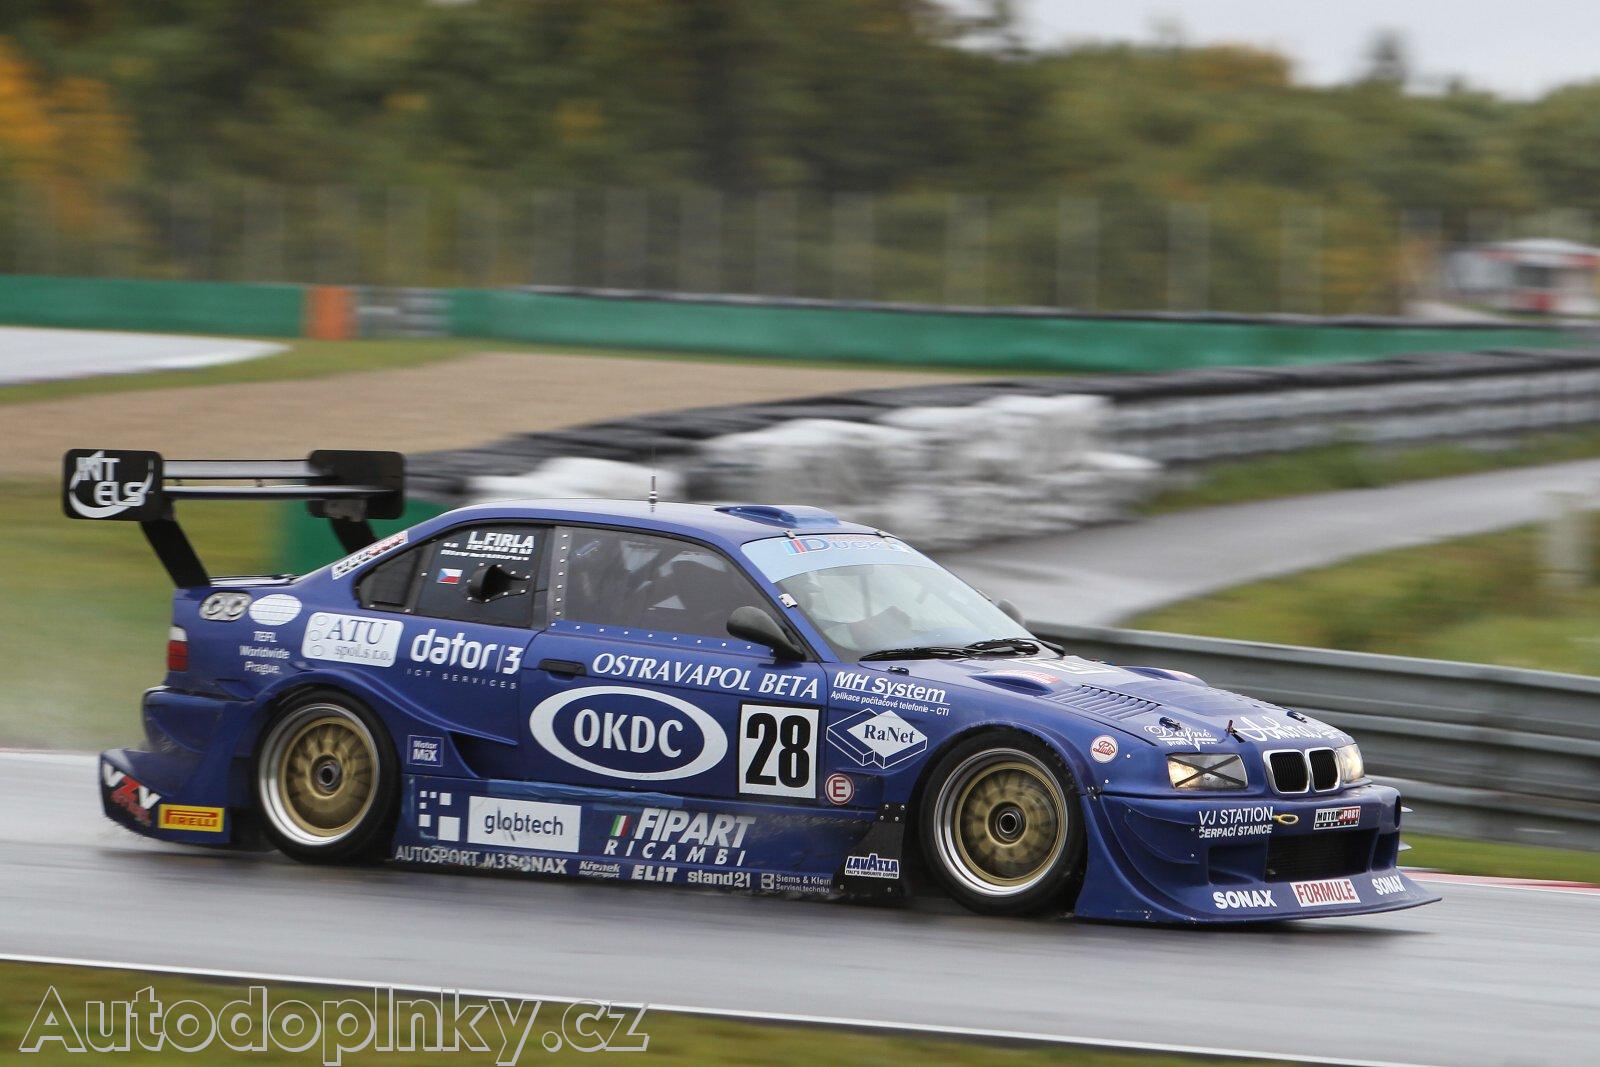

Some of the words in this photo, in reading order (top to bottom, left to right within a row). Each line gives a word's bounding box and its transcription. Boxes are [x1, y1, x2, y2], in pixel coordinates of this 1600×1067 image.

[325, 617, 387, 644] ATU
[239, 645, 290, 660] Worldwide
[244, 661, 281, 676] Prague
[592, 654, 751, 691] OSTRAVAPOL
[759, 673, 818, 699] BETA
[441, 673, 517, 690] SERVICES
[833, 671, 870, 690] MH
[871, 677, 946, 703] System
[831, 691, 861, 703] Aplikace
[899, 701, 929, 713] telefonie
[936, 707, 950, 717] CTI
[574, 708, 683, 758] OKDC
[864, 724, 915, 744] RaNet
[746, 713, 811, 788] 28
[832, 779, 847, 798] E
[484, 805, 564, 836] globtech
[1199, 810, 1216, 826] VJ
[1220, 806, 1274, 822] STATION
[634, 807, 757, 848] FIPART
[1199, 825, 1237, 839] ČERPACÍ
[1238, 824, 1273, 837] STANICE
[395, 845, 481, 867] AUTOSPORT
[604, 839, 745, 867] RICAMBI
[687, 868, 751, 888] stand21
[1371, 875, 1406, 896] SONAX
[1212, 889, 1277, 910] SONAX
[1296, 880, 1356, 904] FORMULE
